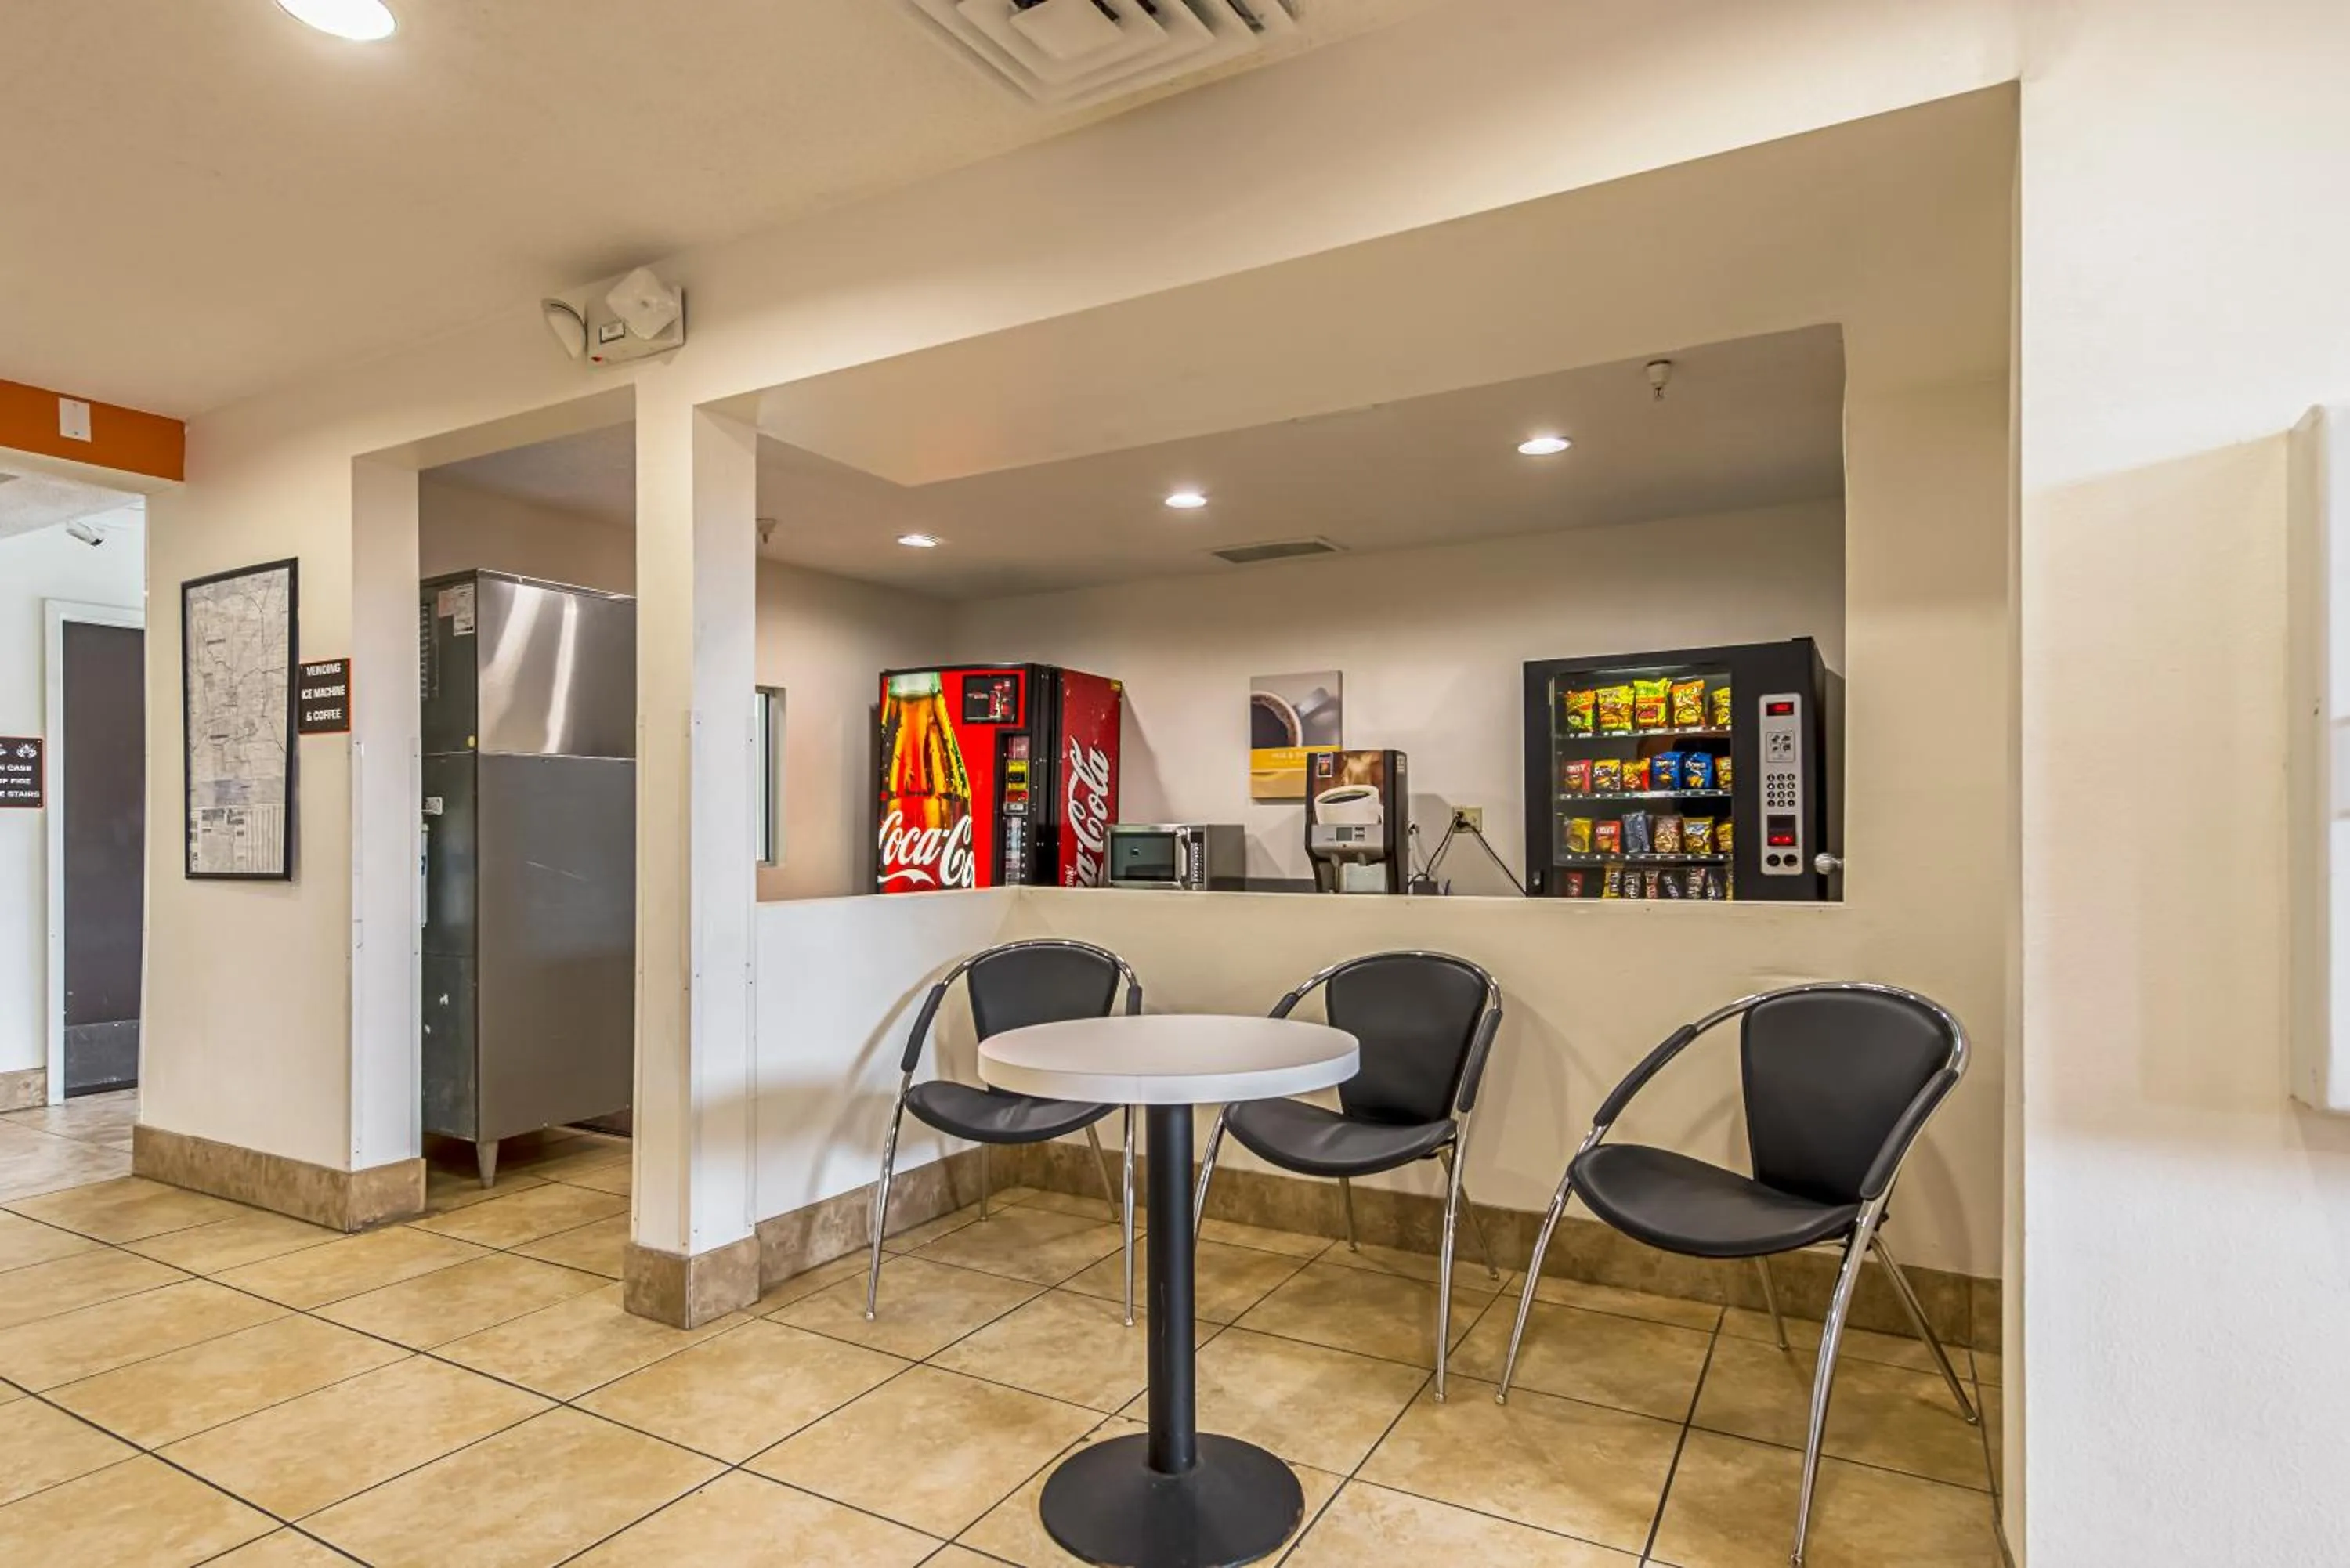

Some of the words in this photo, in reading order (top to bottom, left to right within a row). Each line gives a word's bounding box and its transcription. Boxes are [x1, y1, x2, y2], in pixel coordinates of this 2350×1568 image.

[306, 663, 341, 676] VENDING
[302, 688, 313, 699] ICE
[313, 685, 345, 699] MACHINE
[313, 709, 342, 721] COFFEE
